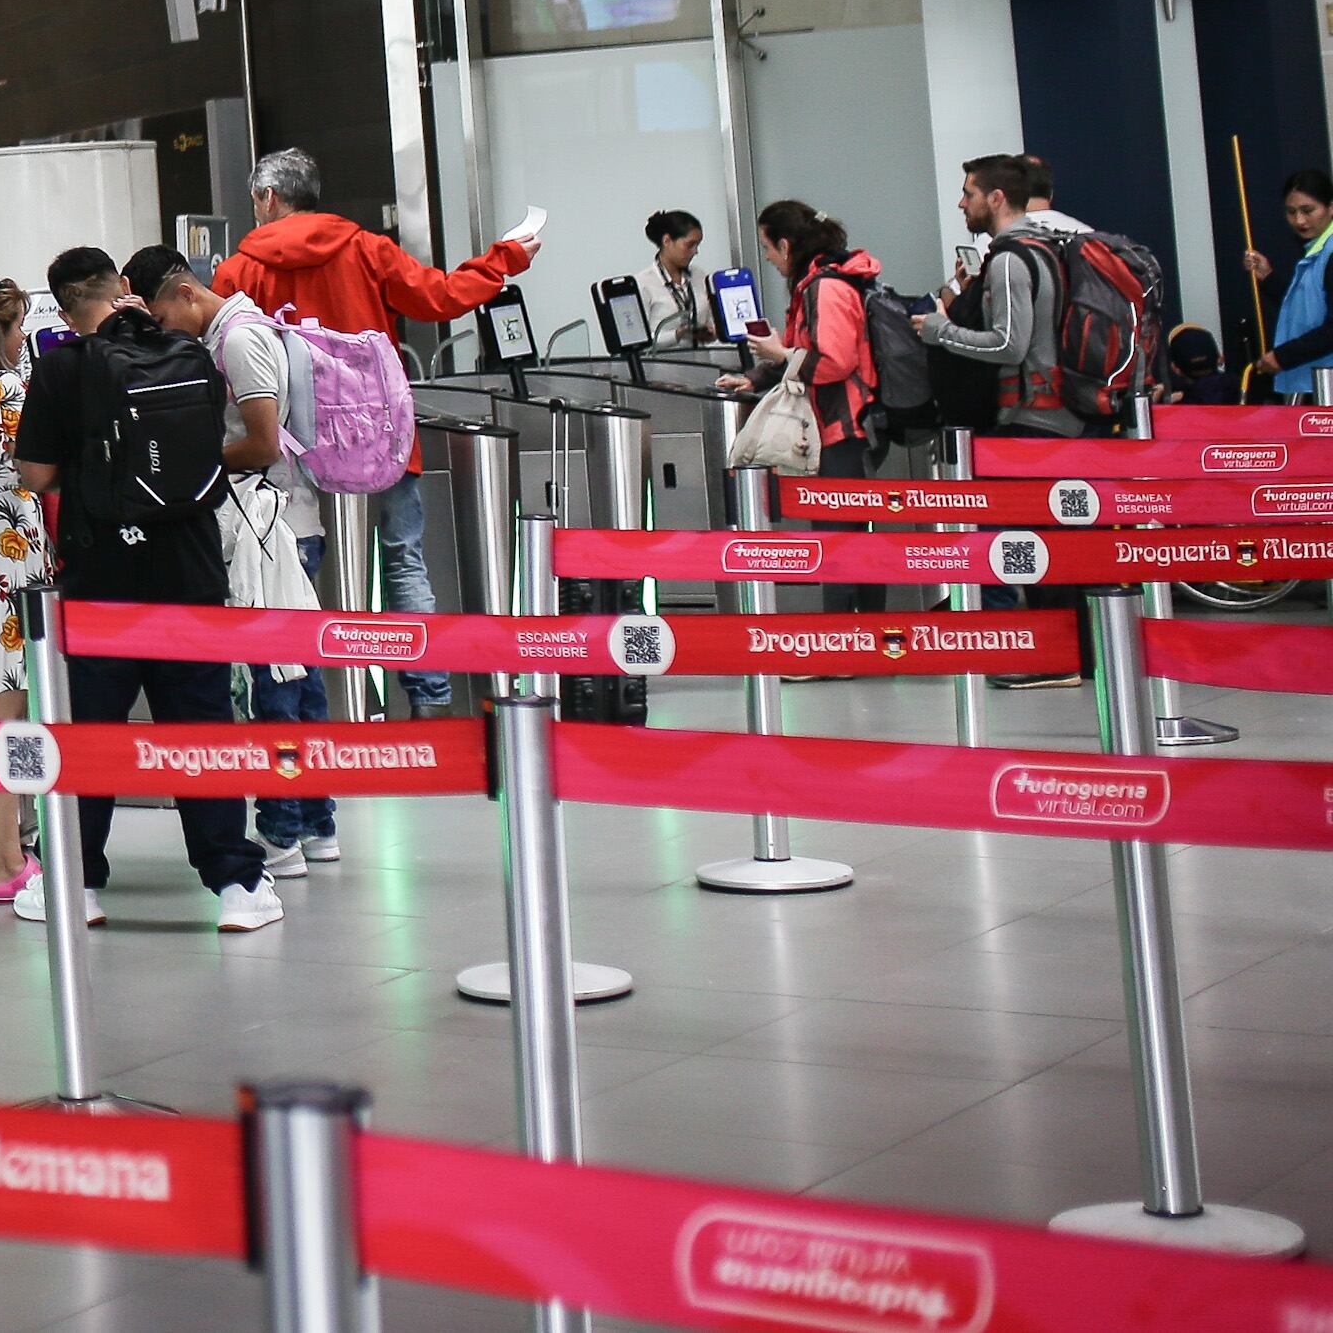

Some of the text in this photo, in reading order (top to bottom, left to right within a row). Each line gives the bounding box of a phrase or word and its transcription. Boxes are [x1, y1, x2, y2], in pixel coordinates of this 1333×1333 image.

[1223, 458, 1275, 468] virtual.com
[797, 487, 988, 508] Droguería Alemana
[1115, 493, 1173, 504] ESCANEA Y
[1116, 504, 1173, 514] DESCUBRE
[905, 546, 970, 556] ESCANEA Y
[1115, 538, 1333, 567] Droguería Alema
[746, 558, 808, 569] virtual.com
[907, 559, 970, 570] DESCUBRE
[517, 632, 589, 644] ESCANEA Y
[748, 623, 1035, 658] Droguería Alemana
[345, 642, 413, 656] virtual.com
[520, 647, 589, 658] DESCUBRE
[135, 739, 437, 777] Droguería Alemana
[1036, 797, 1144, 819] virtual.com
